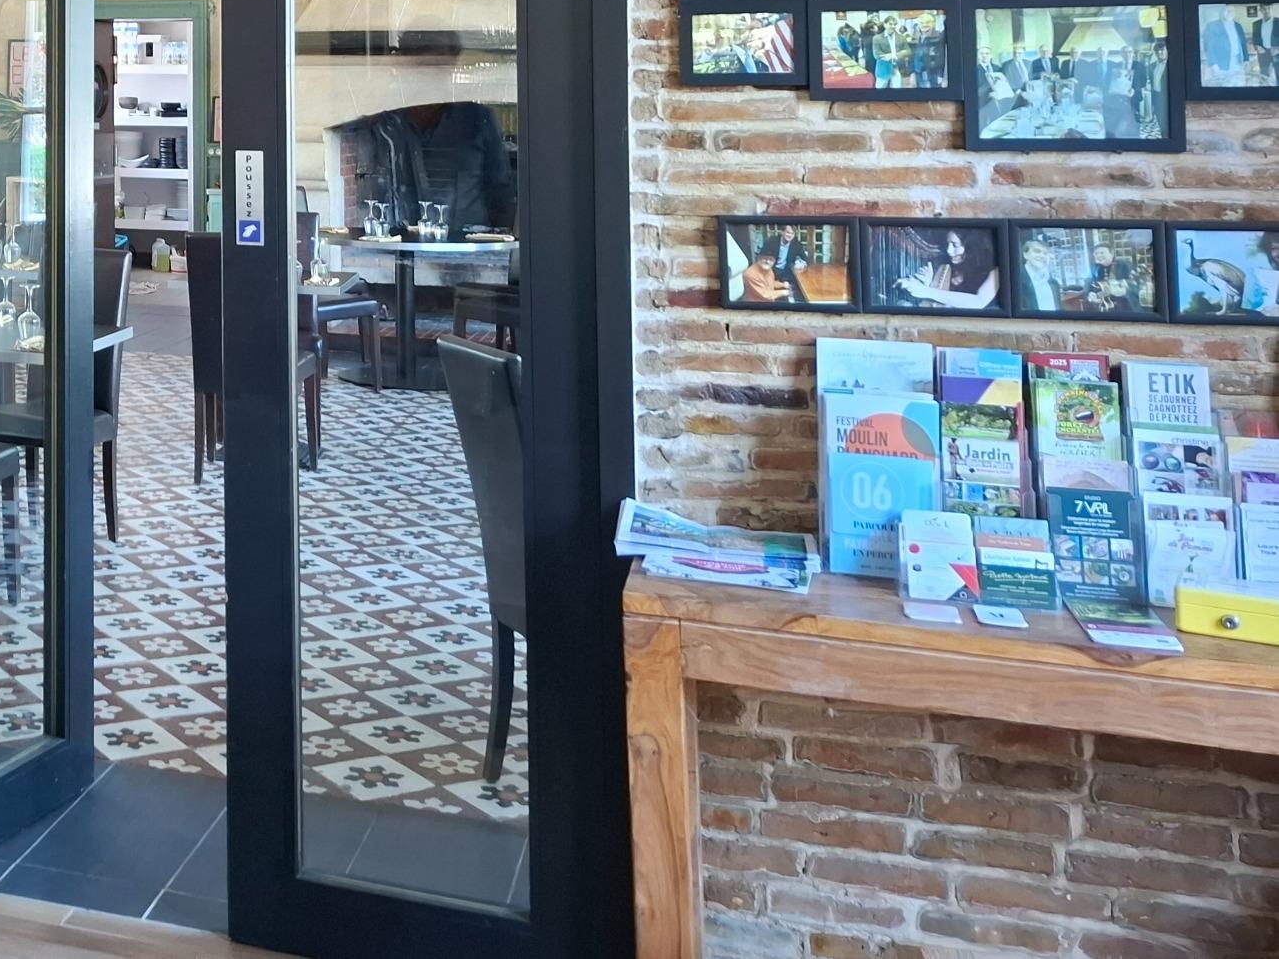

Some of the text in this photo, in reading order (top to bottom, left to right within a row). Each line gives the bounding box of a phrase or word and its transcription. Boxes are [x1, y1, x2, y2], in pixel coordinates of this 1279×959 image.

[1147, 372, 1196, 395] ETIK
[1148, 394, 1197, 405] SEJOURNEZ
[1148, 403, 1198, 414] CAGNOTTEZ
[836, 415, 875, 428] FESTIVAL
[1149, 412, 1198, 424] DEPENSEZ
[836, 428, 888, 447] MOULIN
[965, 443, 1011, 462] Jardin
[852, 471, 893, 511] 06
